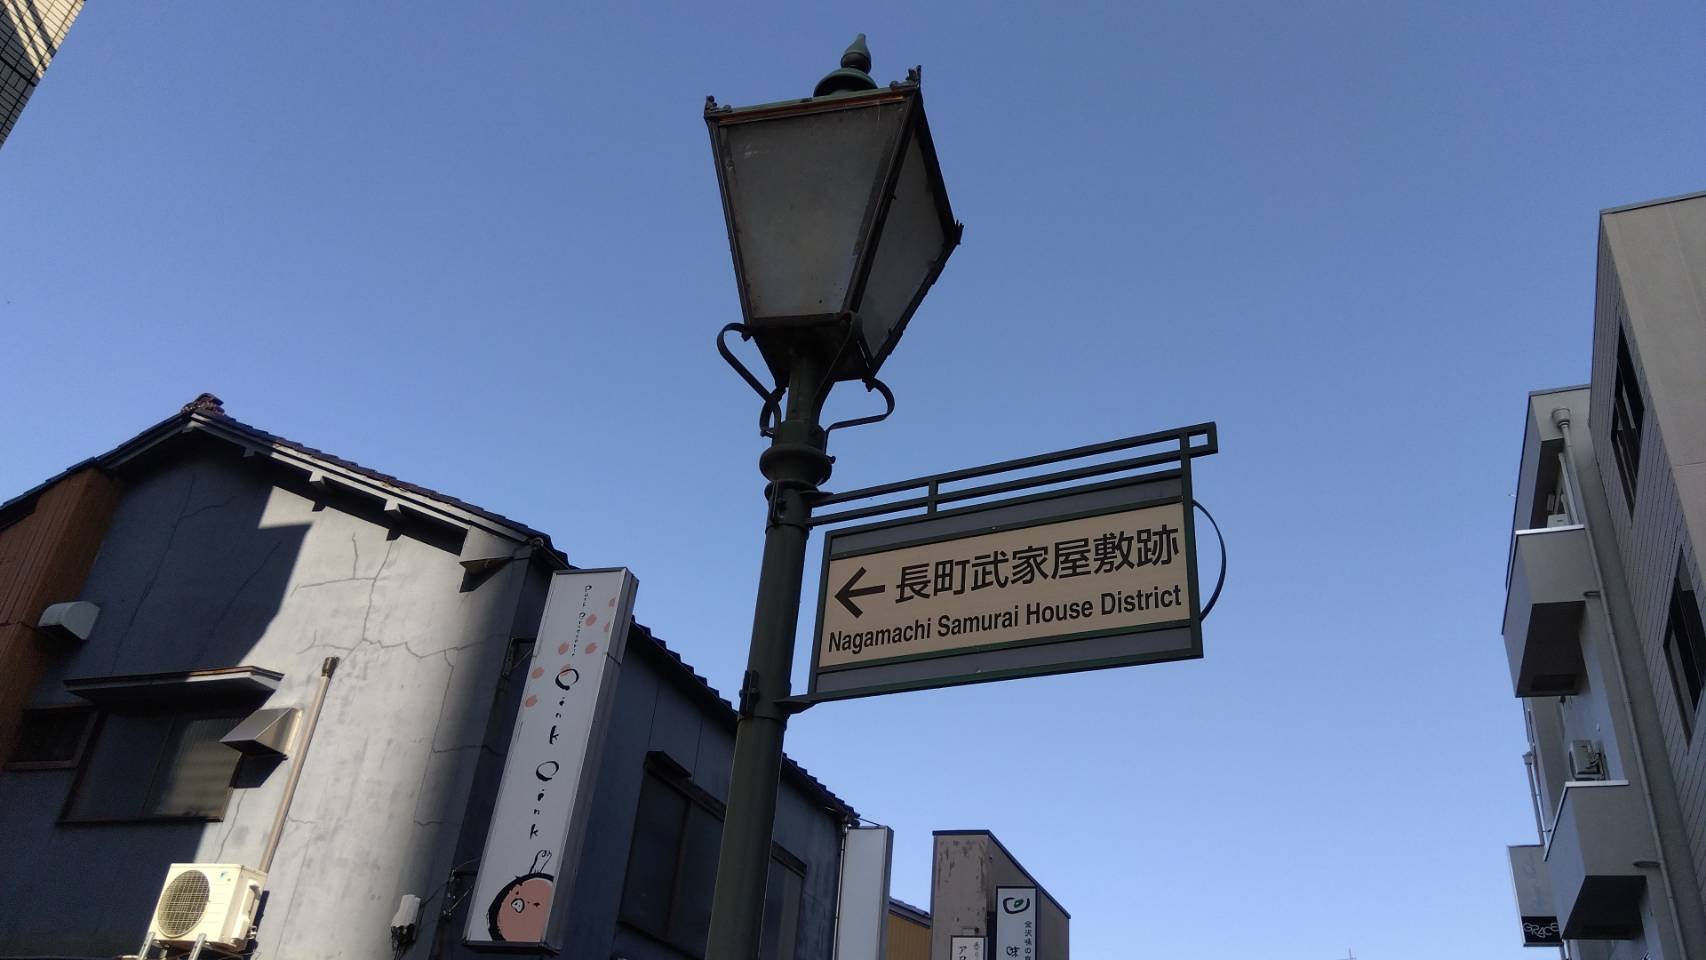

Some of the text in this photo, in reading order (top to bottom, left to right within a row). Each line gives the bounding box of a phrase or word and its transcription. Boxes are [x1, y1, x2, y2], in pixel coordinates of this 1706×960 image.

[895, 524, 1180, 604] 長町武家屋敷跡
[828, 584, 1182, 655] Nagamachi Samurai House District
[549, 668, 579, 744] Oink
[529, 760, 560, 840] Oink
